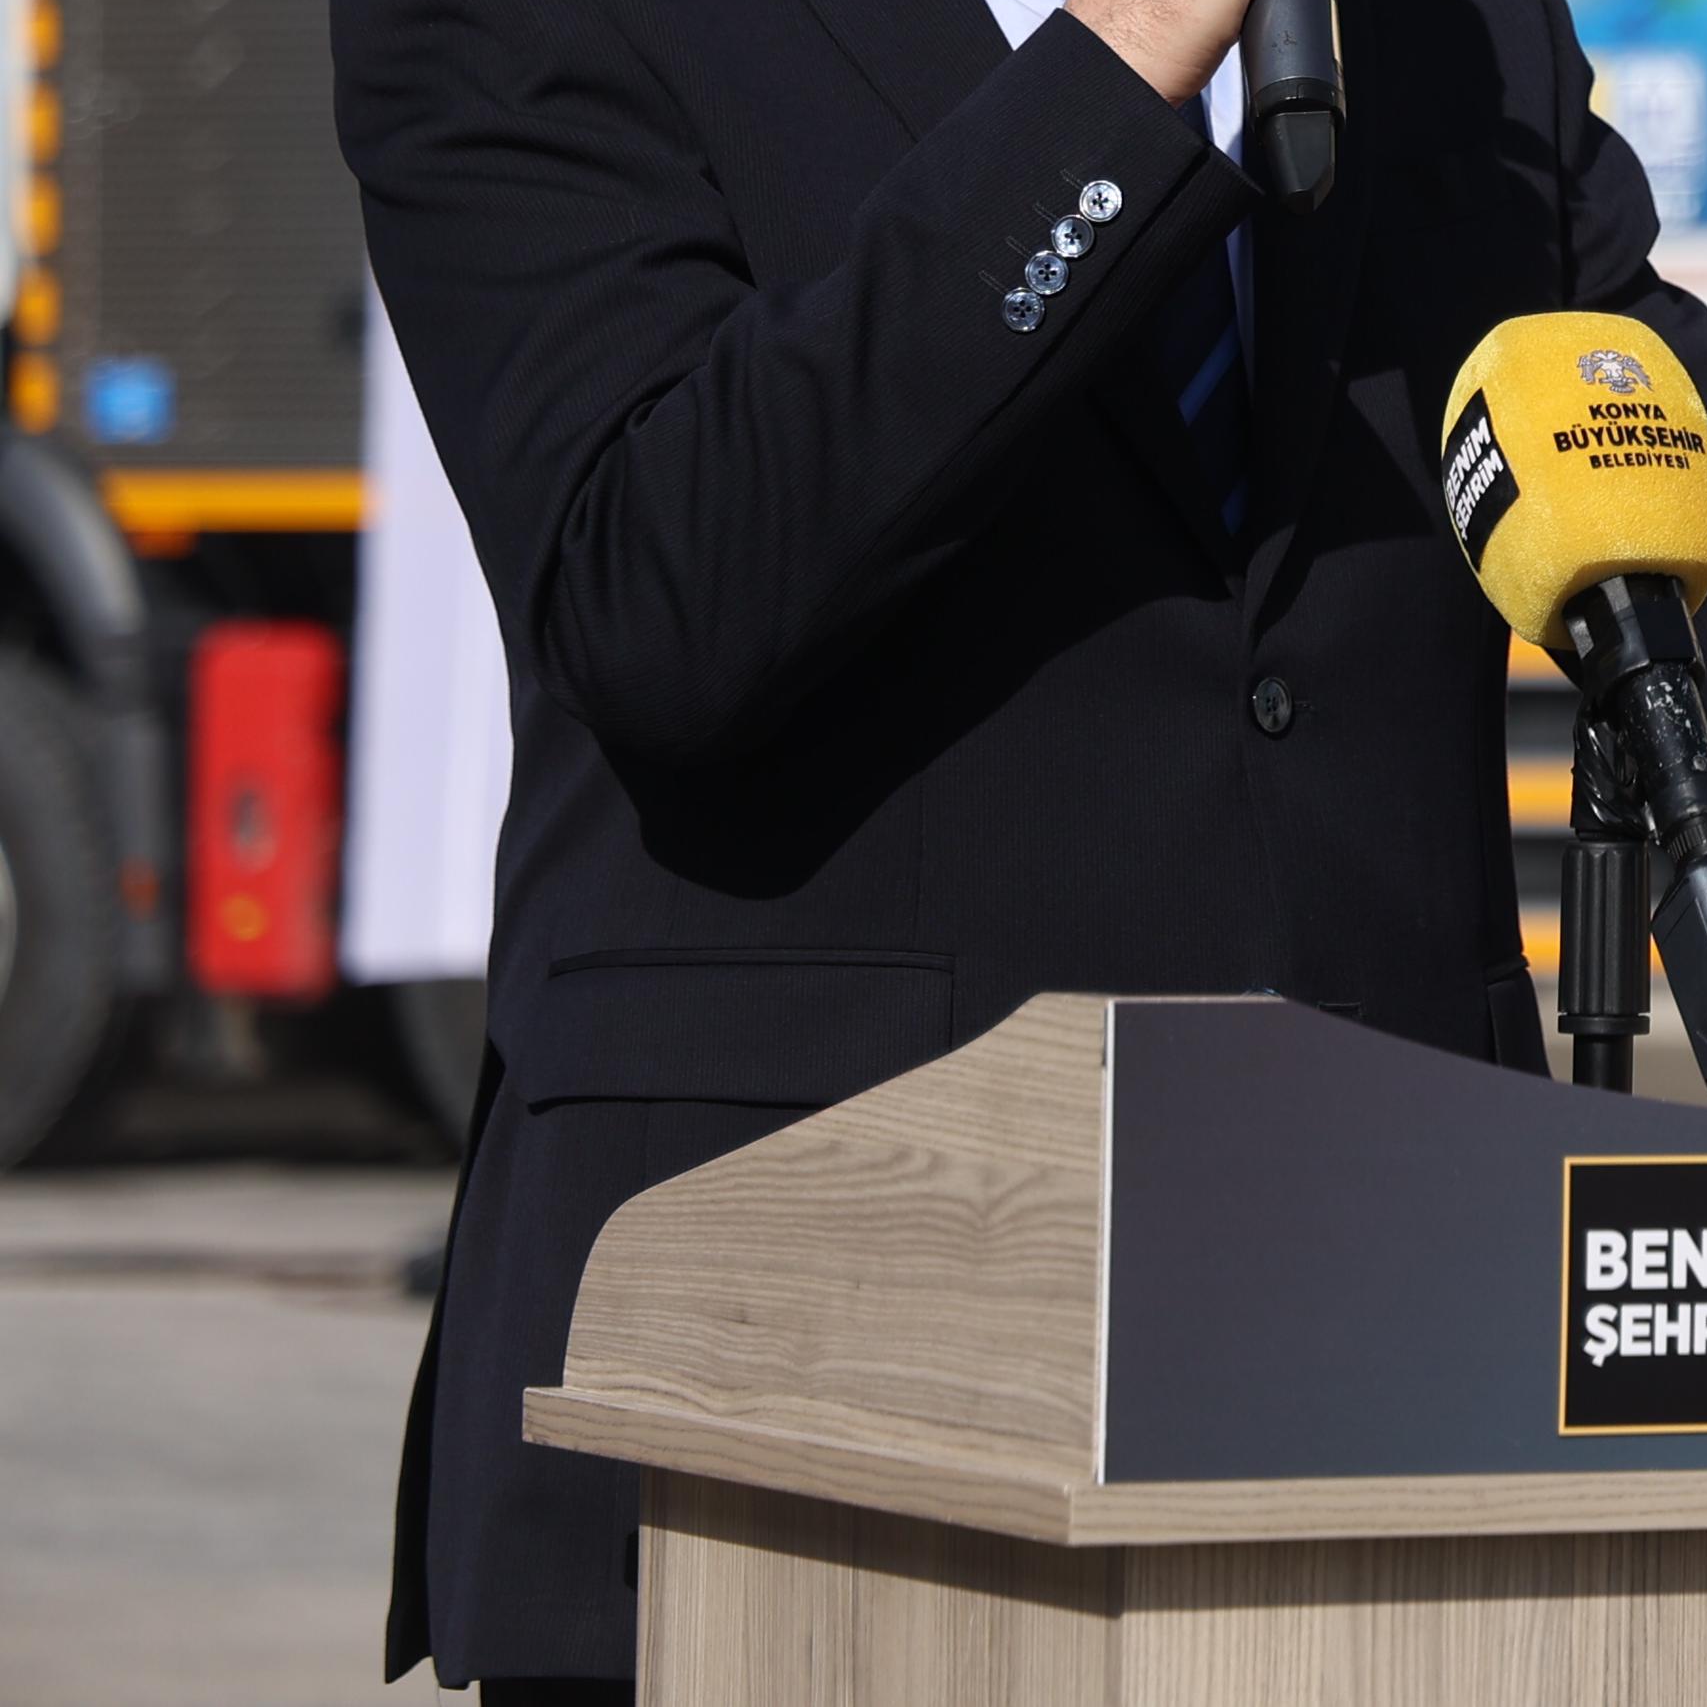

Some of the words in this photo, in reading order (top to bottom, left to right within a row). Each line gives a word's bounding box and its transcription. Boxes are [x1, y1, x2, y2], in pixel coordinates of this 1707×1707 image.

[1589, 403, 1667, 421] KONYA
[1553, 421, 1706, 454] BÜYÜKŞEHİR
[1446, 416, 1491, 511] BENİM
[1589, 449, 1690, 469] BELEDİYESİ
[1455, 448, 1504, 541] ŞEHRİM
